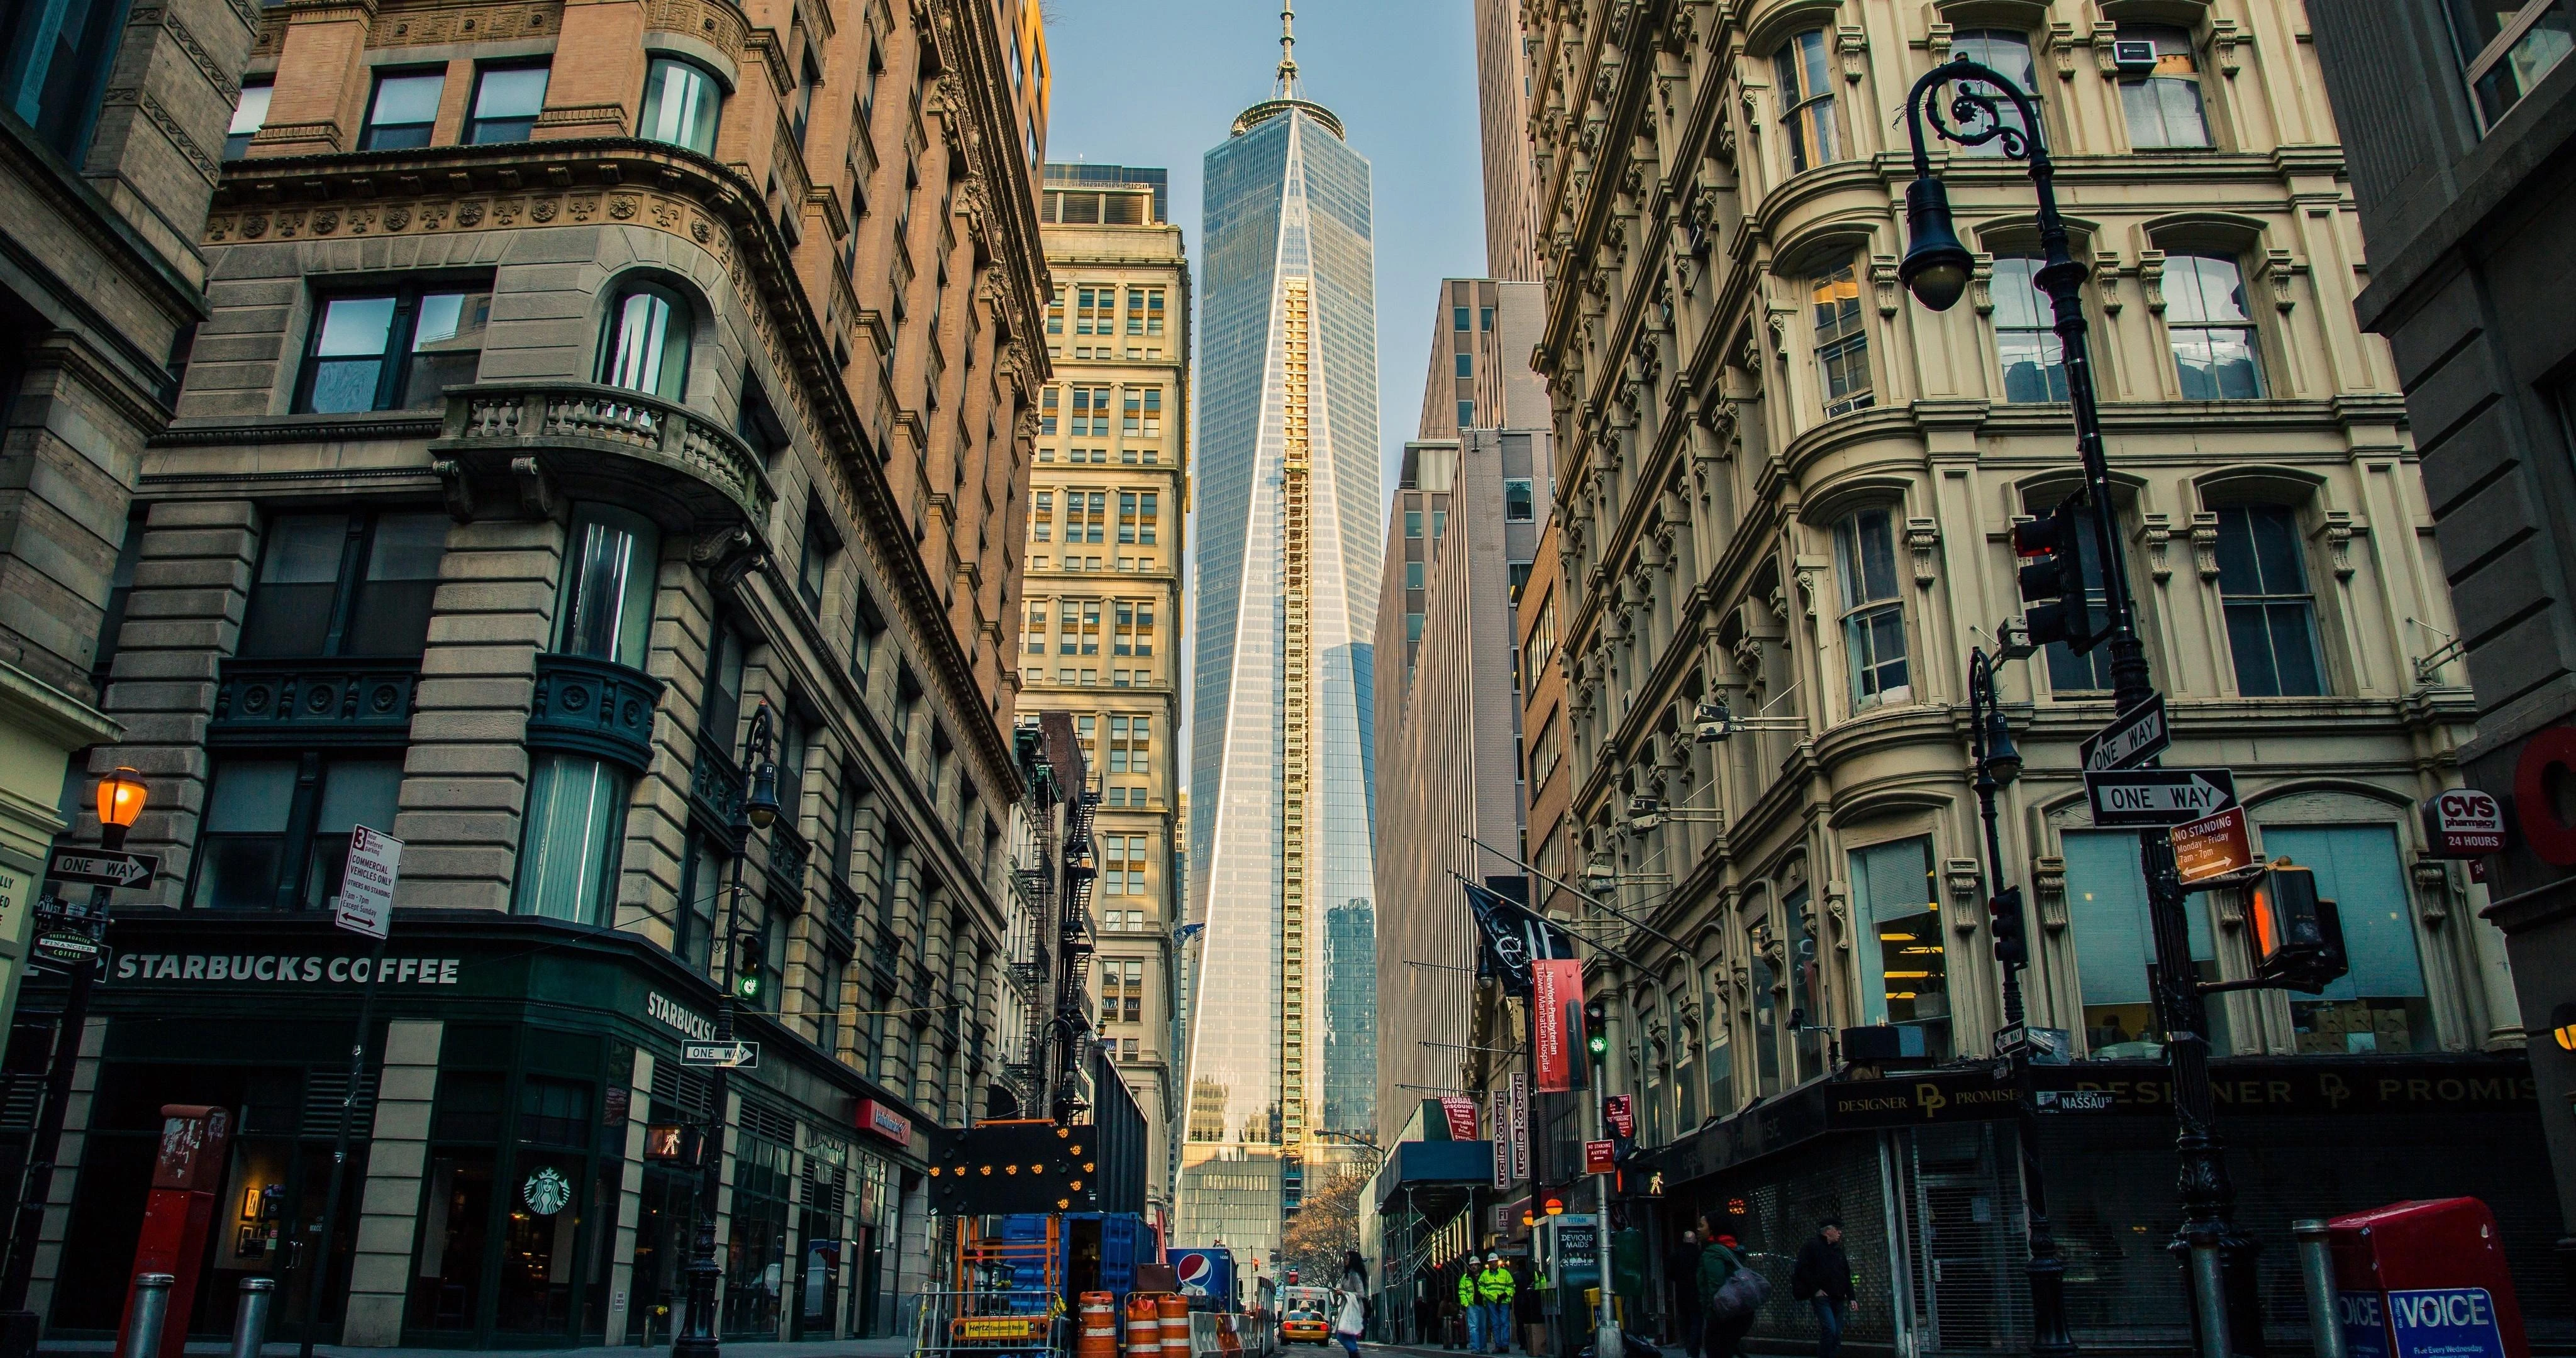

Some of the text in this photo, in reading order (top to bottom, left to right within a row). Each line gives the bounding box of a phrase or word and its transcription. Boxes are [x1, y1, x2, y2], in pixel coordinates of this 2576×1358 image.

[2095, 716, 2153, 770] ONE WAY
[2111, 787, 2212, 809] ONE WAY
[2441, 796, 2495, 817] CVS
[2175, 815, 2232, 842] NO STANDING
[2445, 818, 2496, 829] pharmacy
[355, 829, 365, 848] 3
[366, 839, 383, 850] metered
[2177, 841, 2202, 853] Monday
[2208, 832, 2229, 844] Friday
[2448, 836, 2499, 846] 24 HOURS
[365, 846, 380, 856] parking
[2179, 854, 2194, 864] 7am
[2199, 847, 2214, 859] 7pm
[63, 858, 140, 878] ONE WAY
[352, 855, 388, 875] COMMERCIAL
[2475, 863, 2484, 874] 24
[350, 865, 392, 886] VEHICLES ONLY
[345, 890, 355, 899] 7am
[359, 895, 369, 905] 7pm
[347, 879, 364, 890] OTHERS
[371, 886, 391, 899] STANDING
[342, 900, 377, 917] Except Sunday
[68, 935, 91, 944] ROASTED
[54, 949, 80, 958] COFFEE
[118, 954, 460, 983] STARBUCKS COFFEE
[648, 991, 711, 1041] STARBUCKS
[1538, 996, 1546, 1039] Manhattan
[1546, 971, 1557, 1056] NewYork-Presbyterian
[2009, 1030, 2020, 1043] WAY
[693, 1048, 746, 1059] ONE WAY
[1540, 1040, 1551, 1073] Hospital
[2379, 1076, 2537, 1103] PROMIS
[1838, 1096, 1908, 1113] DESIGNER
[1955, 1088, 2018, 1105] PROMISE
[2062, 1096, 2106, 1109] NASSAU
[1514, 1074, 1525, 1177] Lucille Roberts
[1498, 1145, 1506, 1188] Lucille
[1561, 1234, 1593, 1242] DEVIOUS
[2339, 1296, 2381, 1327] OICE
[2399, 1294, 2489, 1328] VOICE
[2445, 1345, 2484, 1353] Wednesday.
